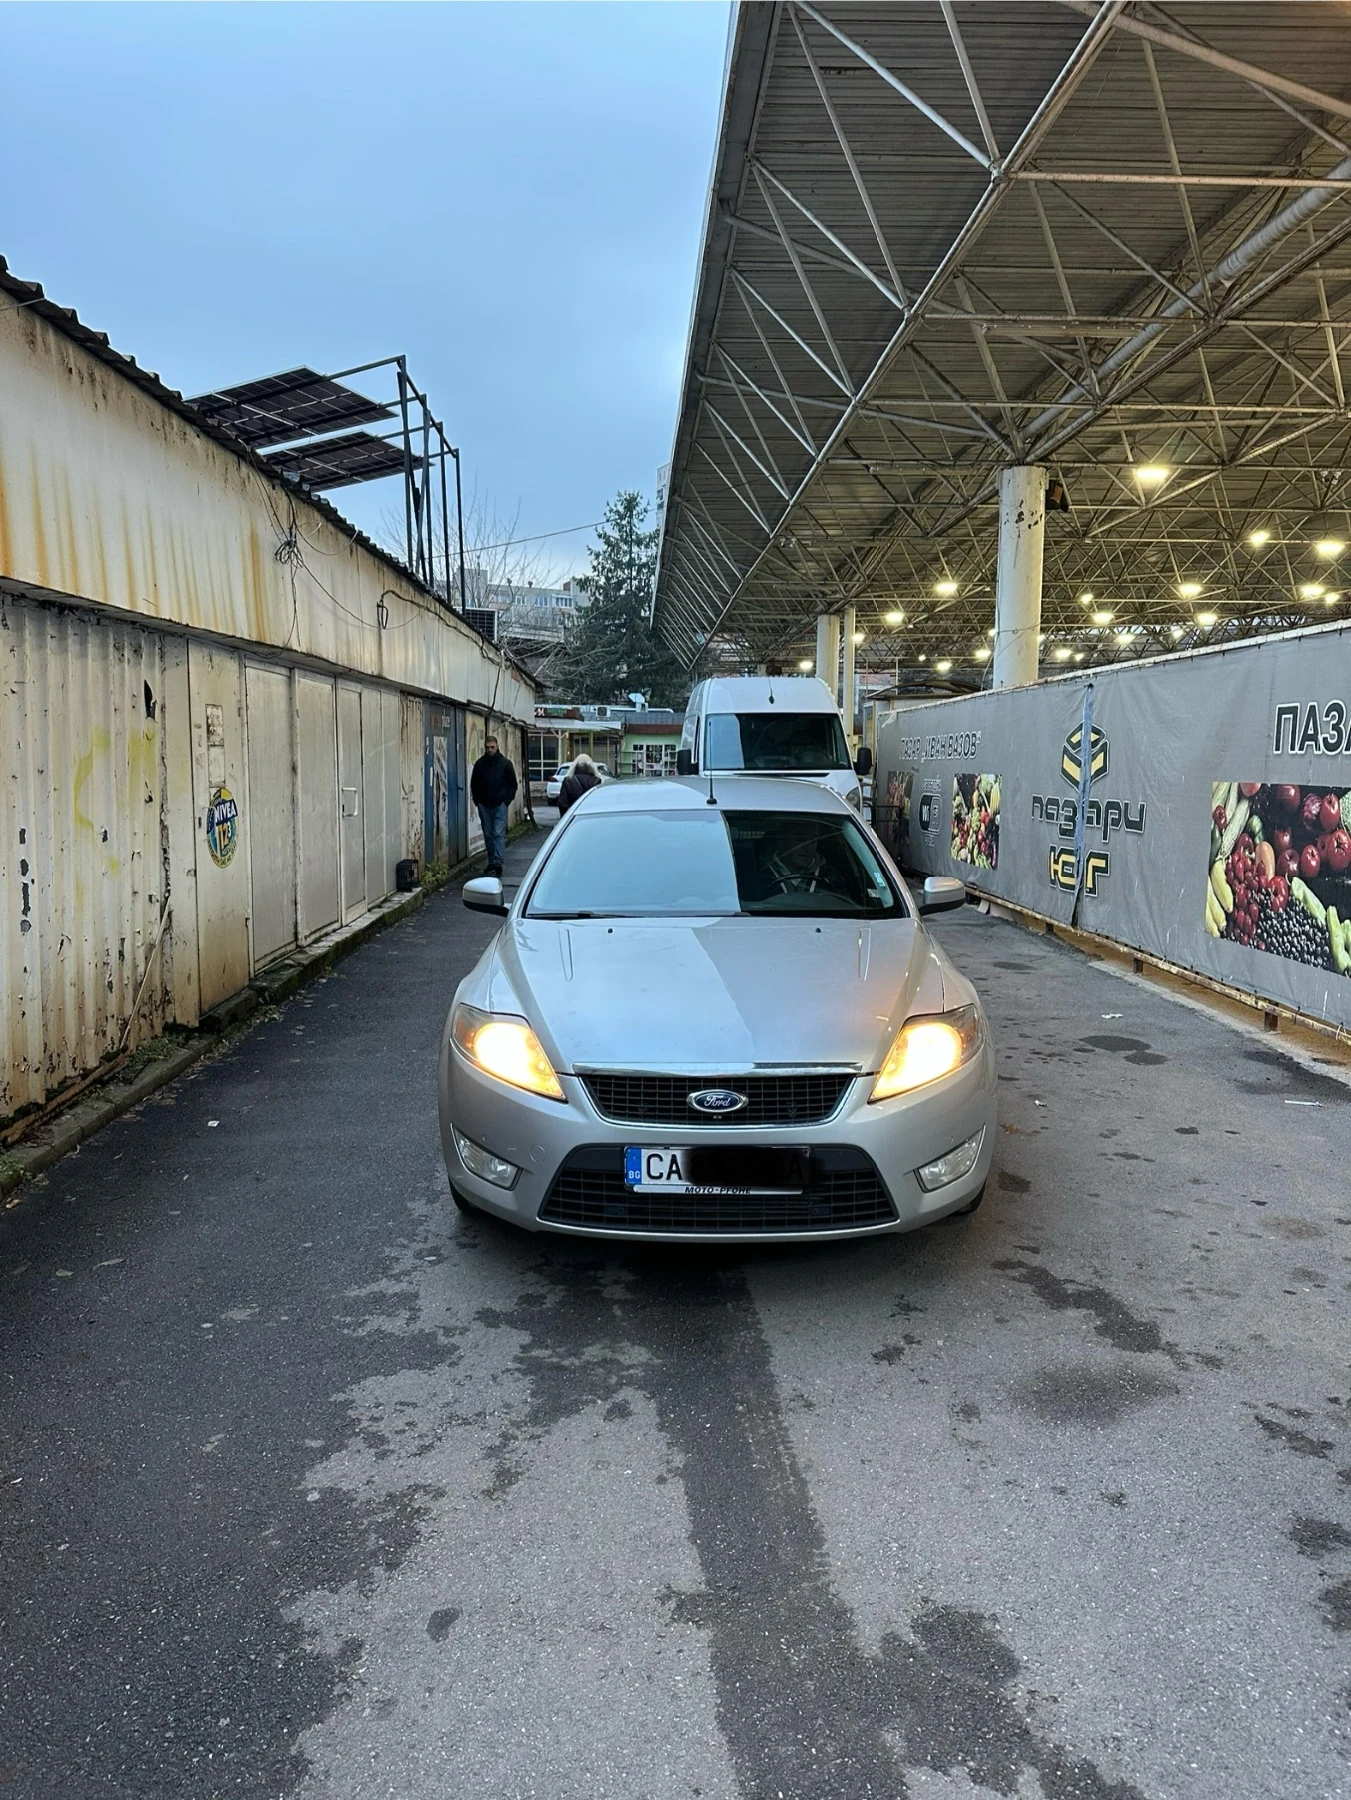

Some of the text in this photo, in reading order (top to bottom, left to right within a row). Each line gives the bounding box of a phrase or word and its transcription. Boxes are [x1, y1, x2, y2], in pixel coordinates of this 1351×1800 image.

[1273, 699, 1351, 755] ПАЗ
[214, 800, 236, 823] NIVEA
[703, 1093, 732, 1108] Ford
[628, 1170, 641, 1180] BG
